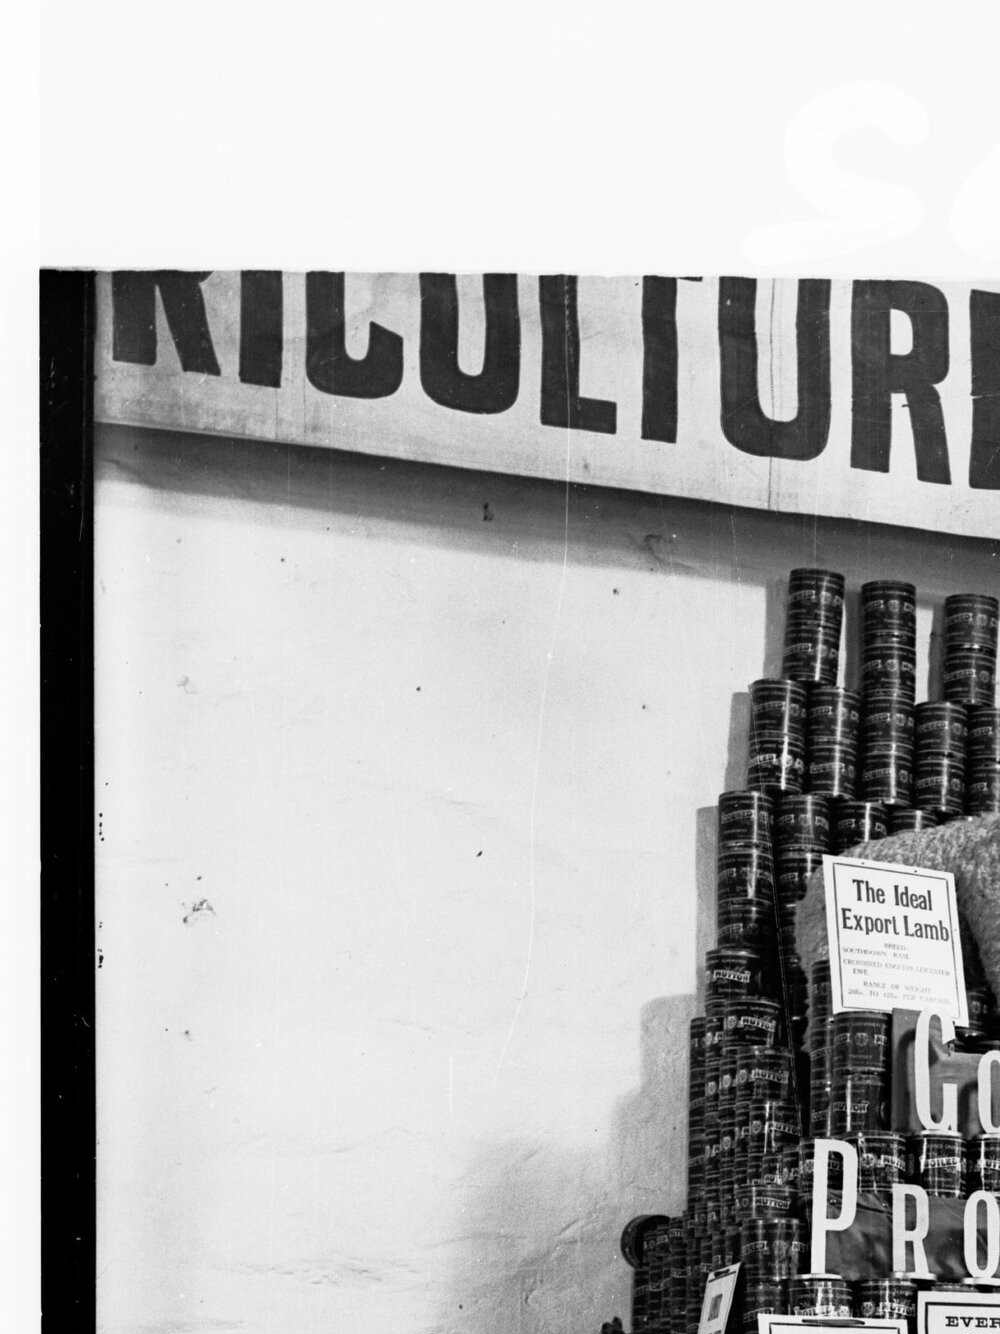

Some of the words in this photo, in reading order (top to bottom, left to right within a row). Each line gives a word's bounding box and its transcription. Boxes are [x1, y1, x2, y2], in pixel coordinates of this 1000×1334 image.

[852, 878, 886, 905] The
[893, 885, 933, 912] Ideal
[841, 907, 900, 936] Export
[903, 915, 950, 942] Lamb
